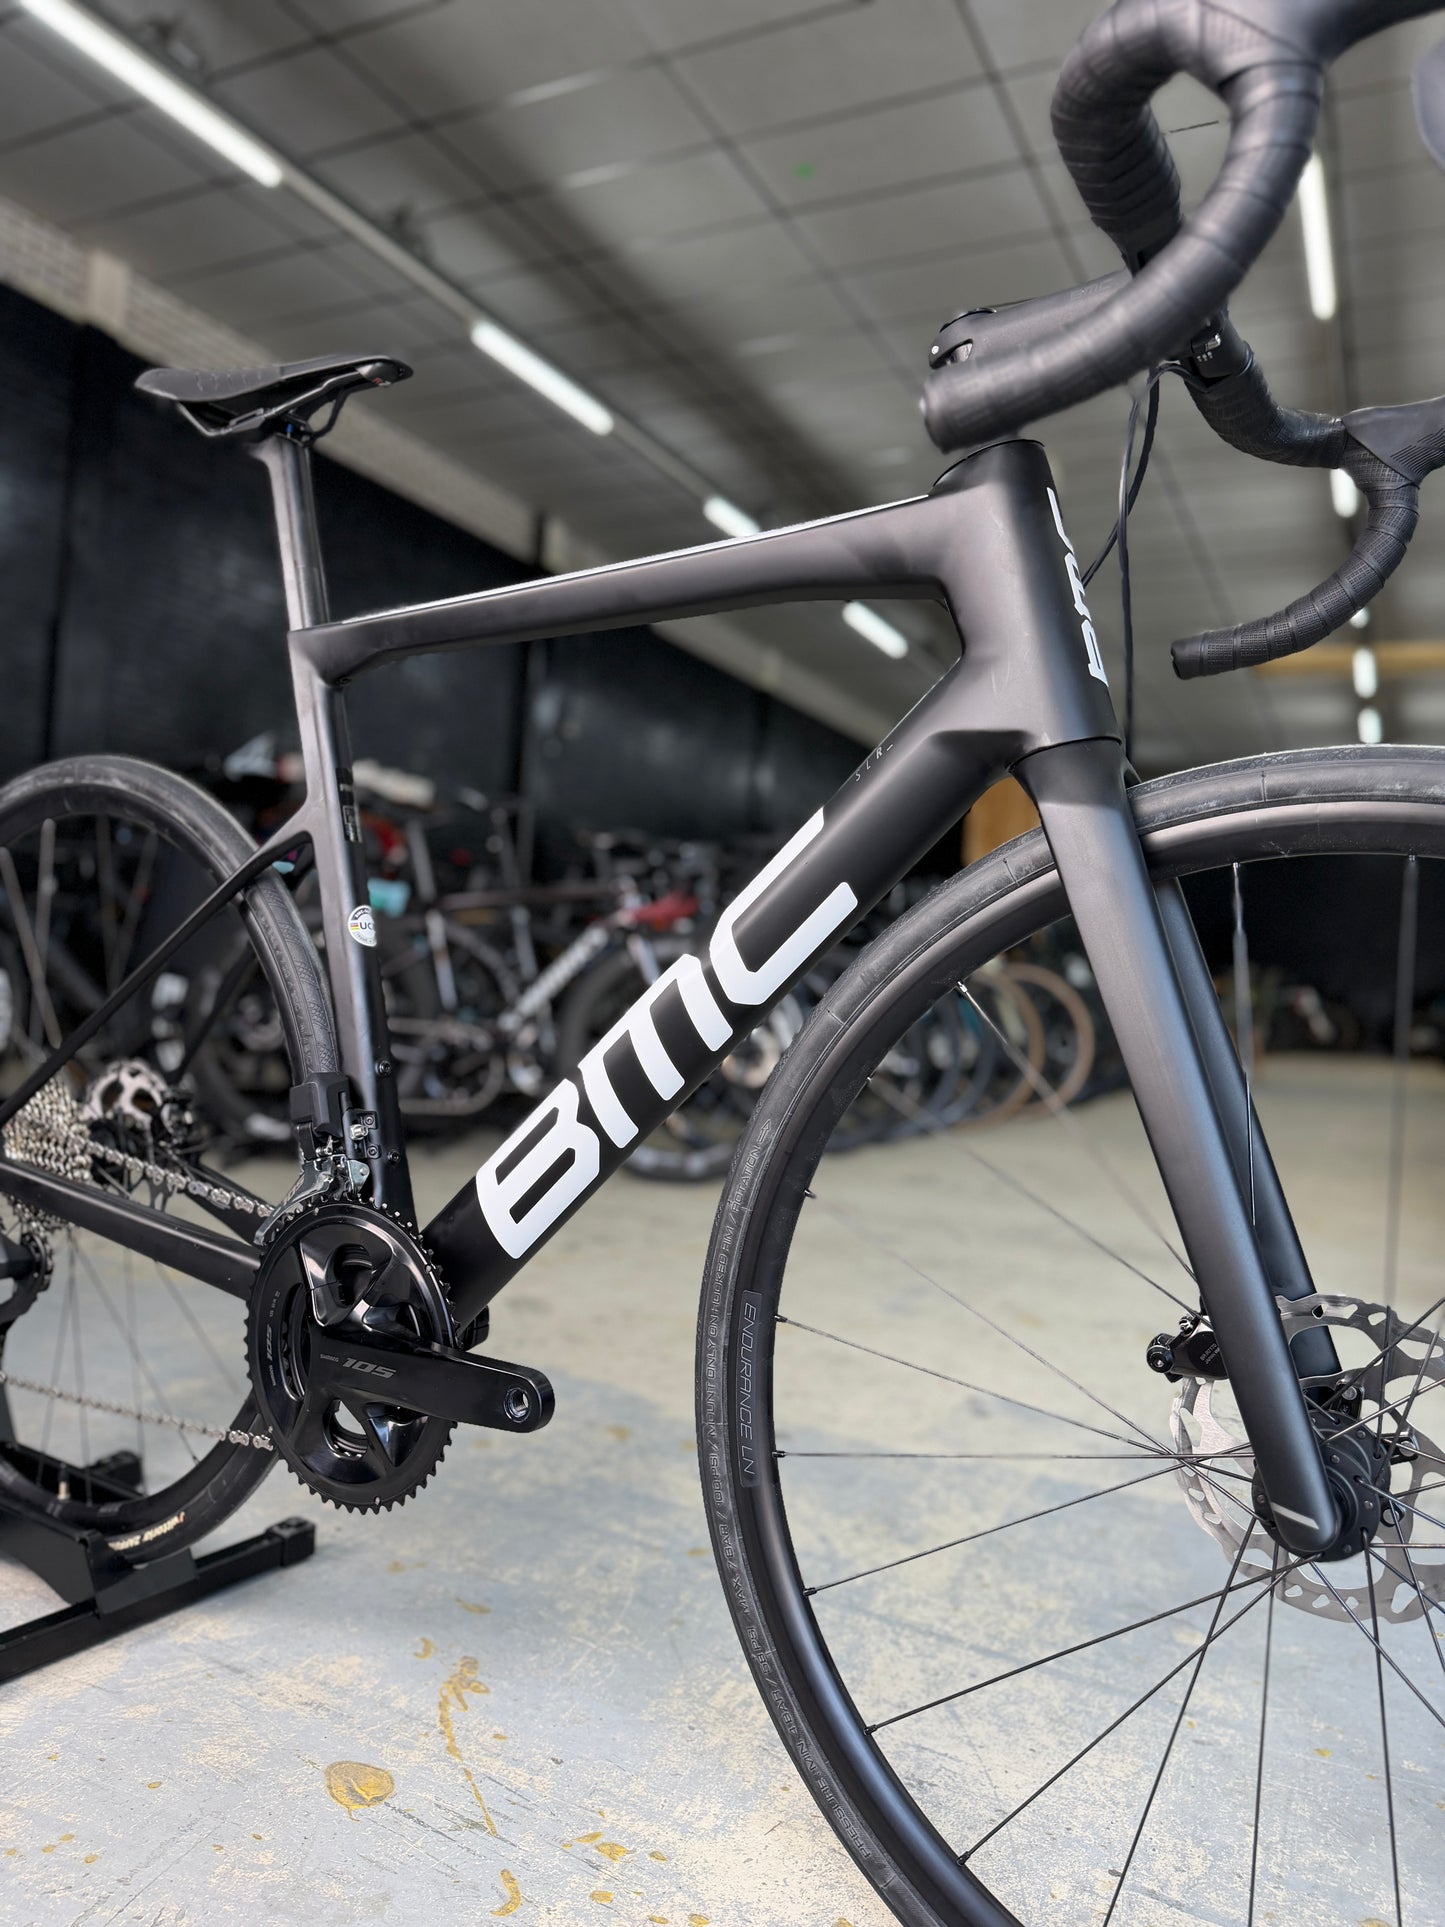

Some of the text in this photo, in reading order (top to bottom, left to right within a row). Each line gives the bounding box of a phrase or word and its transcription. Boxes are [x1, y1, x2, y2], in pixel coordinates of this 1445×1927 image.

[476, 806, 858, 1259] BMC
[731, 1145, 761, 1213] ROTATION
[721, 1225, 734, 1250] RIM
[711, 1253, 729, 1314] HOOKED
[708, 1314, 719, 1338] ON
[342, 1357, 397, 1379] 105
[706, 1339, 717, 1378] ONLY
[705, 1382, 718, 1437] MOUNT
[739, 1302, 757, 1475] ENDURANCE LN
[719, 1524, 736, 1558] BAR
[772, 1689, 792, 1726] BAR
[817, 1778, 871, 1860] PRESSURE
